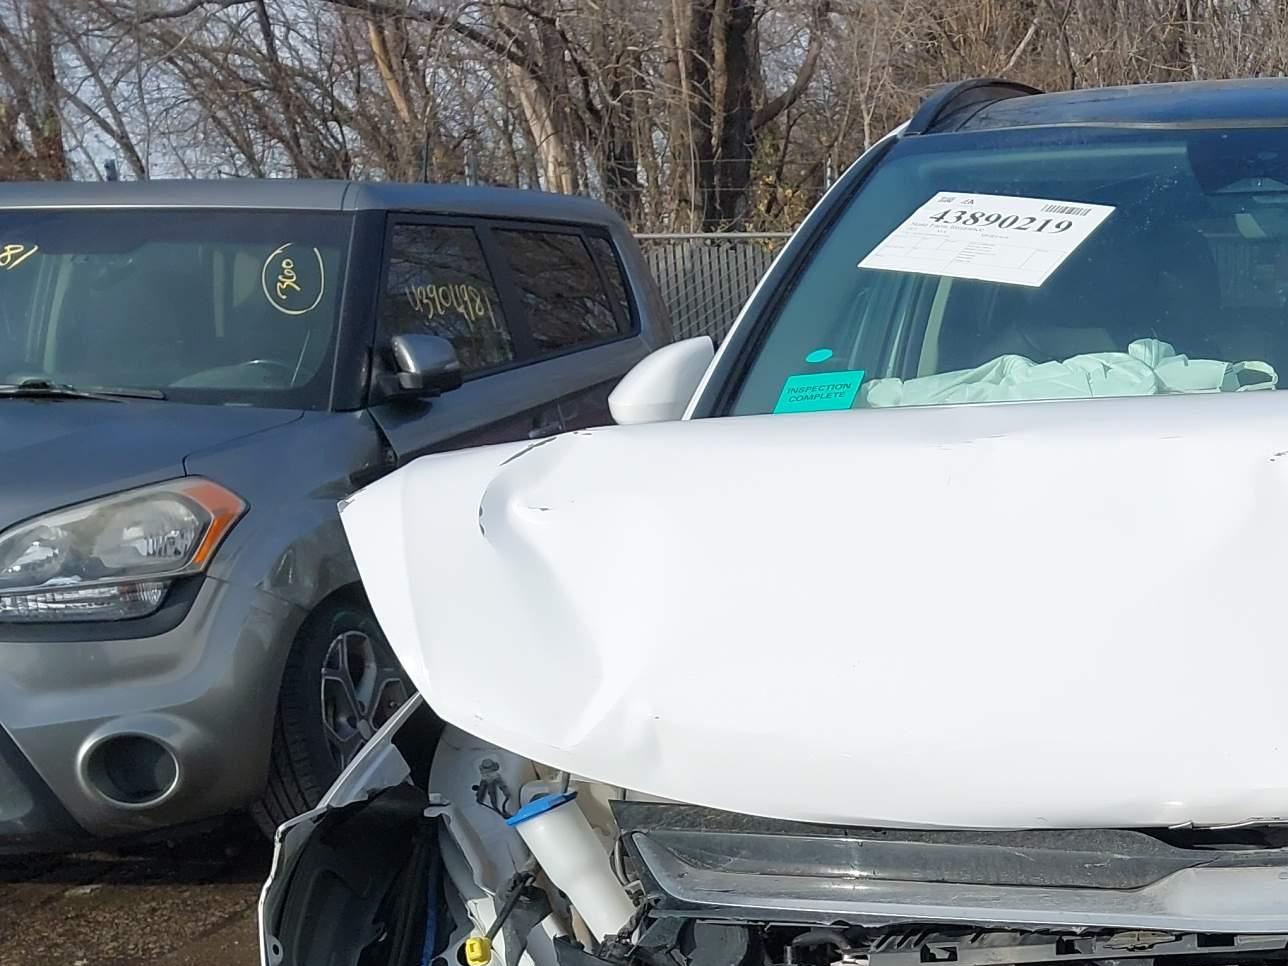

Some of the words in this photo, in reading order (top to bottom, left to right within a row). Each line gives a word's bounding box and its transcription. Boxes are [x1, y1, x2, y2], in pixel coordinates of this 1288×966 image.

[929, 208, 1073, 234] 43890219
[786, 383, 852, 395] INSPECTION
[788, 391, 846, 403] COMPLETE
